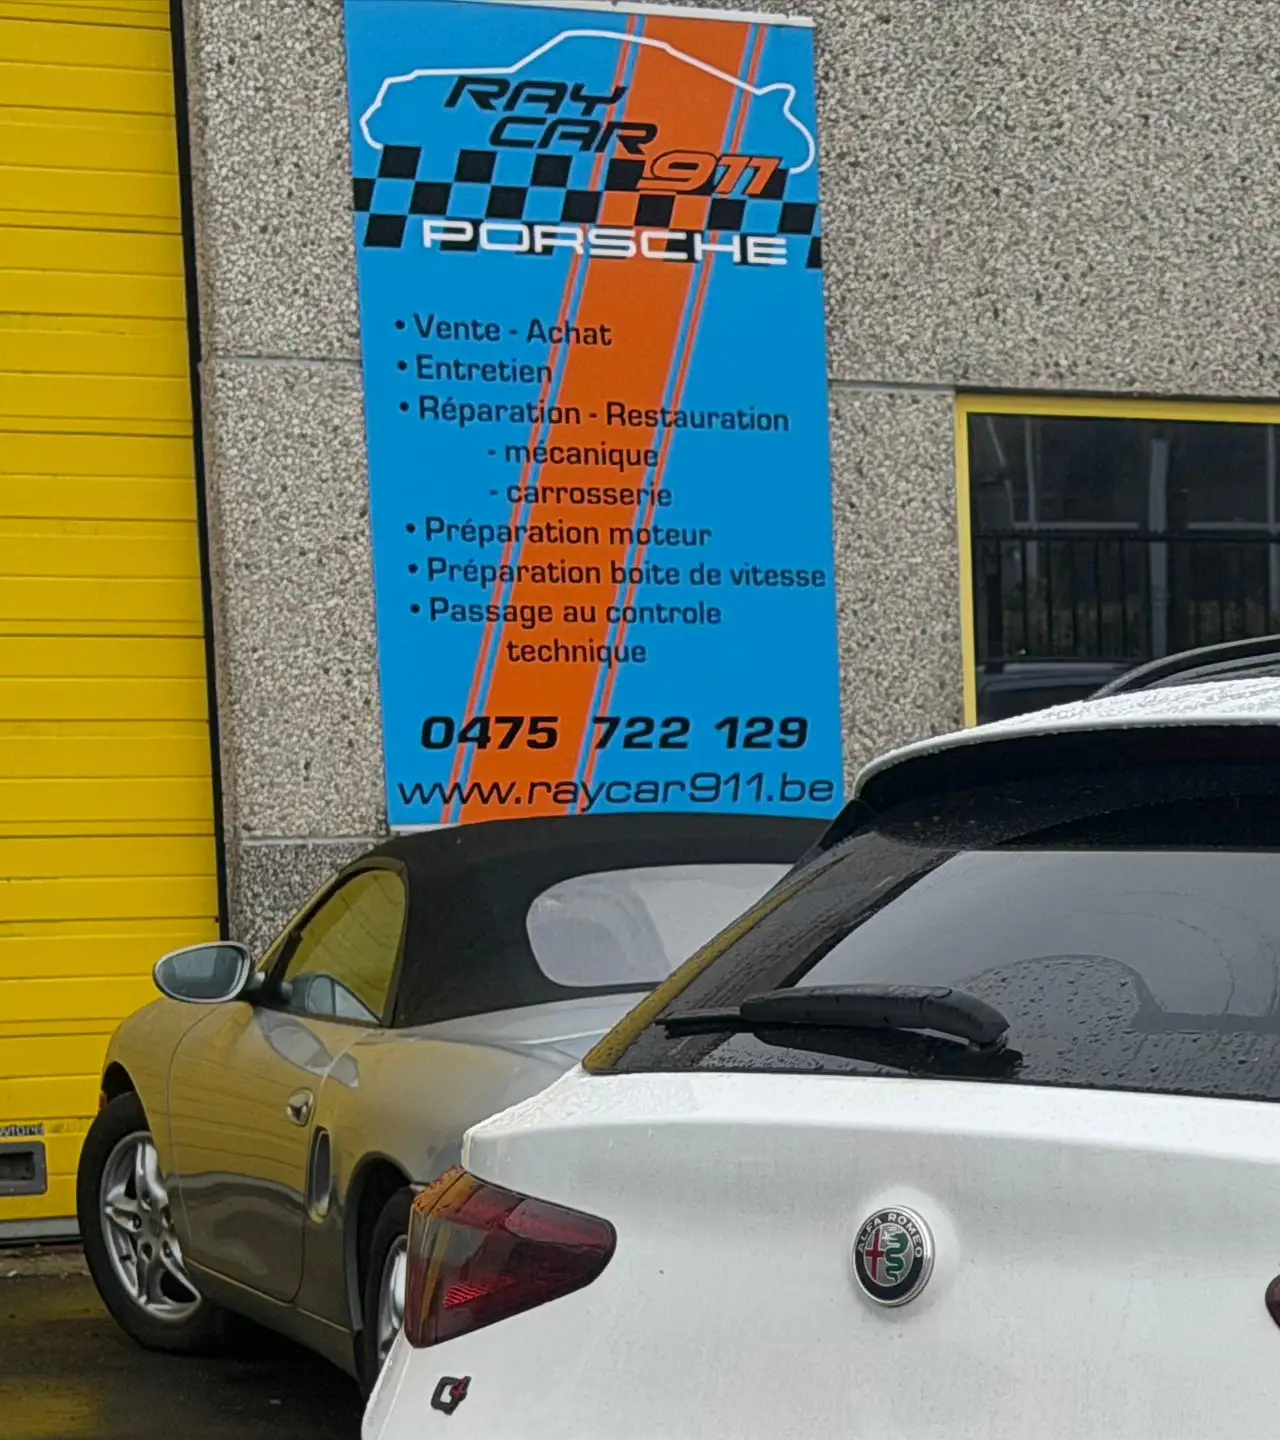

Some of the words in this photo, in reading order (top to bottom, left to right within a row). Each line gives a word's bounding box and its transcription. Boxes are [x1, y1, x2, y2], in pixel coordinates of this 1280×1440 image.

[443, 75, 629, 116] RAY
[489, 116, 658, 155] CAR
[635, 149, 784, 198] 911
[422, 220, 788, 265] PORSCHE
[413, 313, 500, 342] Vente
[526, 318, 613, 347] Achat
[416, 354, 553, 384] Entretien
[418, 395, 582, 428] Réparation
[605, 401, 790, 432] Restauration
[505, 441, 659, 472] mécanique
[506, 480, 673, 507] carrosserie
[425, 516, 600, 548] Préparation
[609, 525, 712, 547] moteur
[427, 556, 602, 589] Préparation
[610, 560, 681, 586] boite
[689, 561, 722, 587] de
[729, 563, 827, 589] vitesse
[429, 597, 553, 629] Passage
[563, 605, 597, 624] au
[605, 600, 722, 626] controle
[506, 639, 648, 669] technique
[421, 715, 559, 750] 0475
[592, 715, 691, 750] 722
[714, 715, 808, 750] 129
[397, 771, 835, 812] www.raycar911.be
[858, 1217, 883, 1253] ALFA
[887, 1212, 923, 1259] ROMEO
